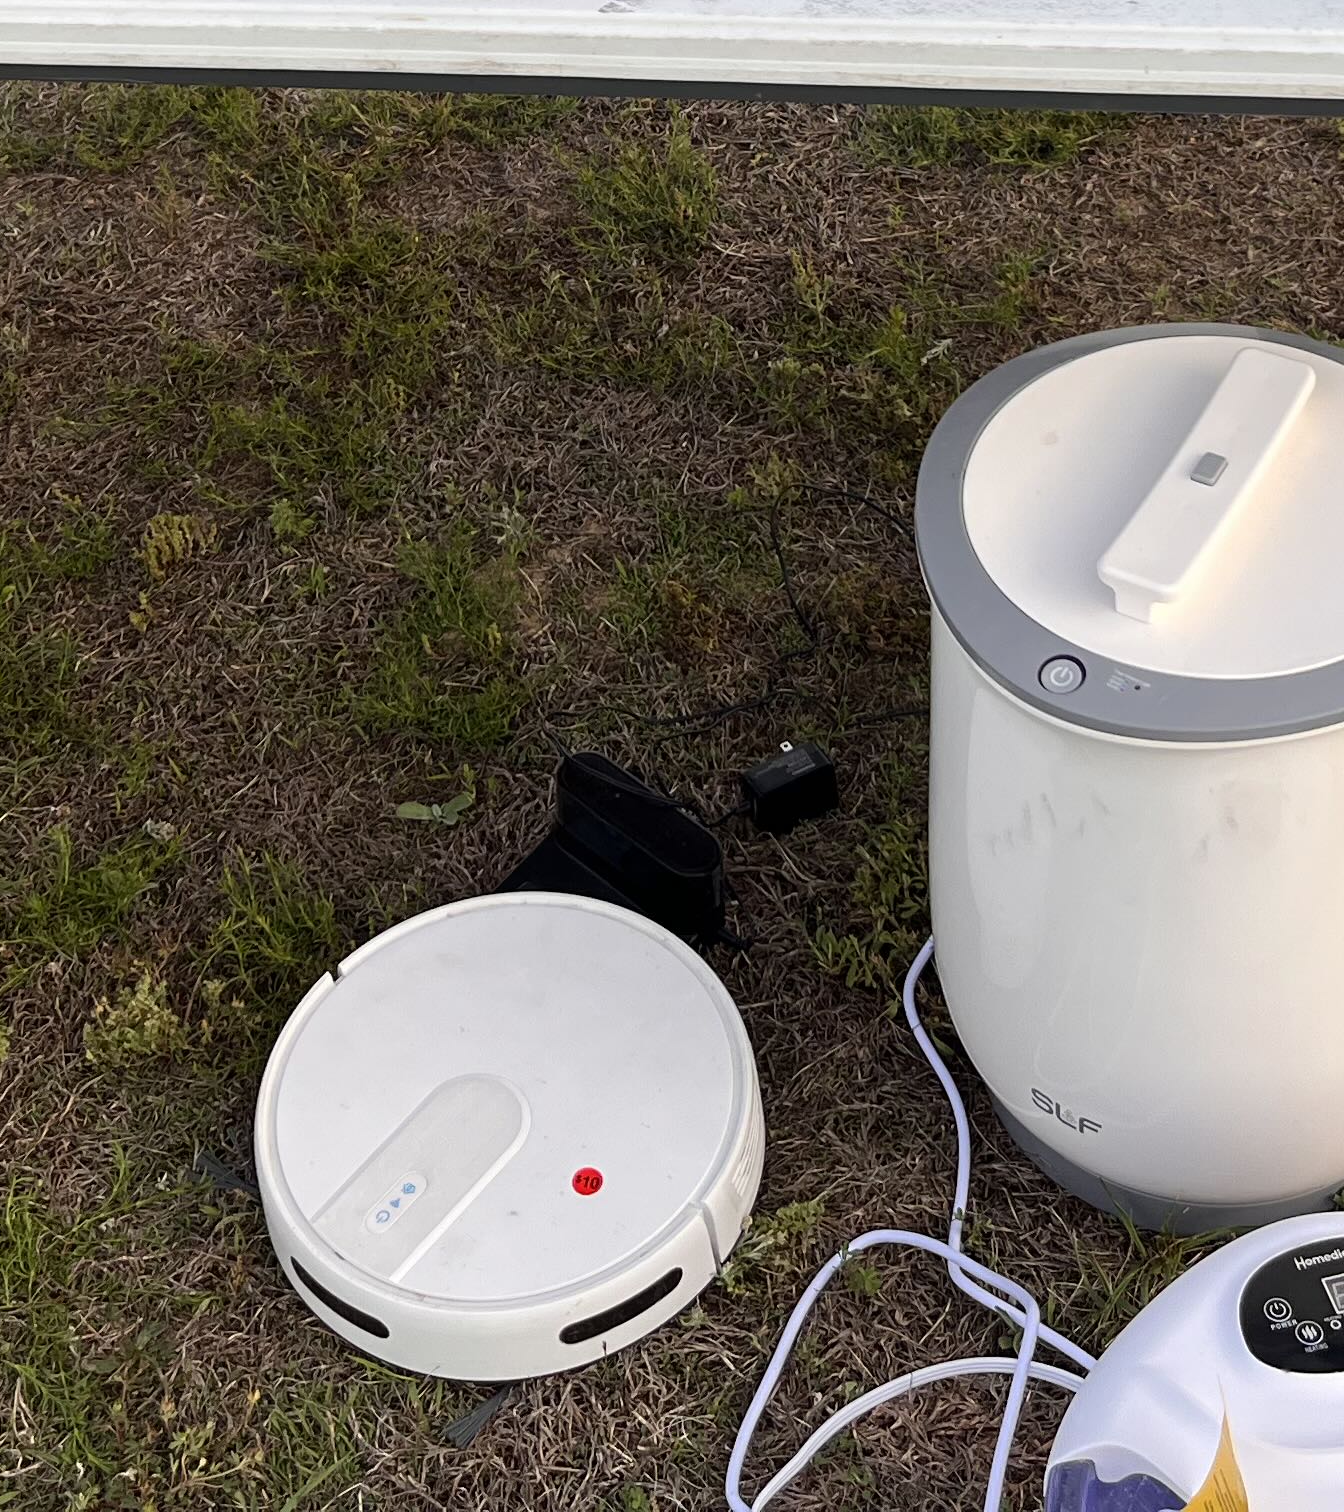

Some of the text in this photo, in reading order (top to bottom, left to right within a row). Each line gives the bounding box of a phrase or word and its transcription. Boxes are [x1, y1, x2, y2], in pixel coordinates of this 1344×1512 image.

[1031, 1087, 1102, 1134] SLF
[575, 1174, 601, 1190] $10
[1270, 1318, 1298, 1331] POWER
